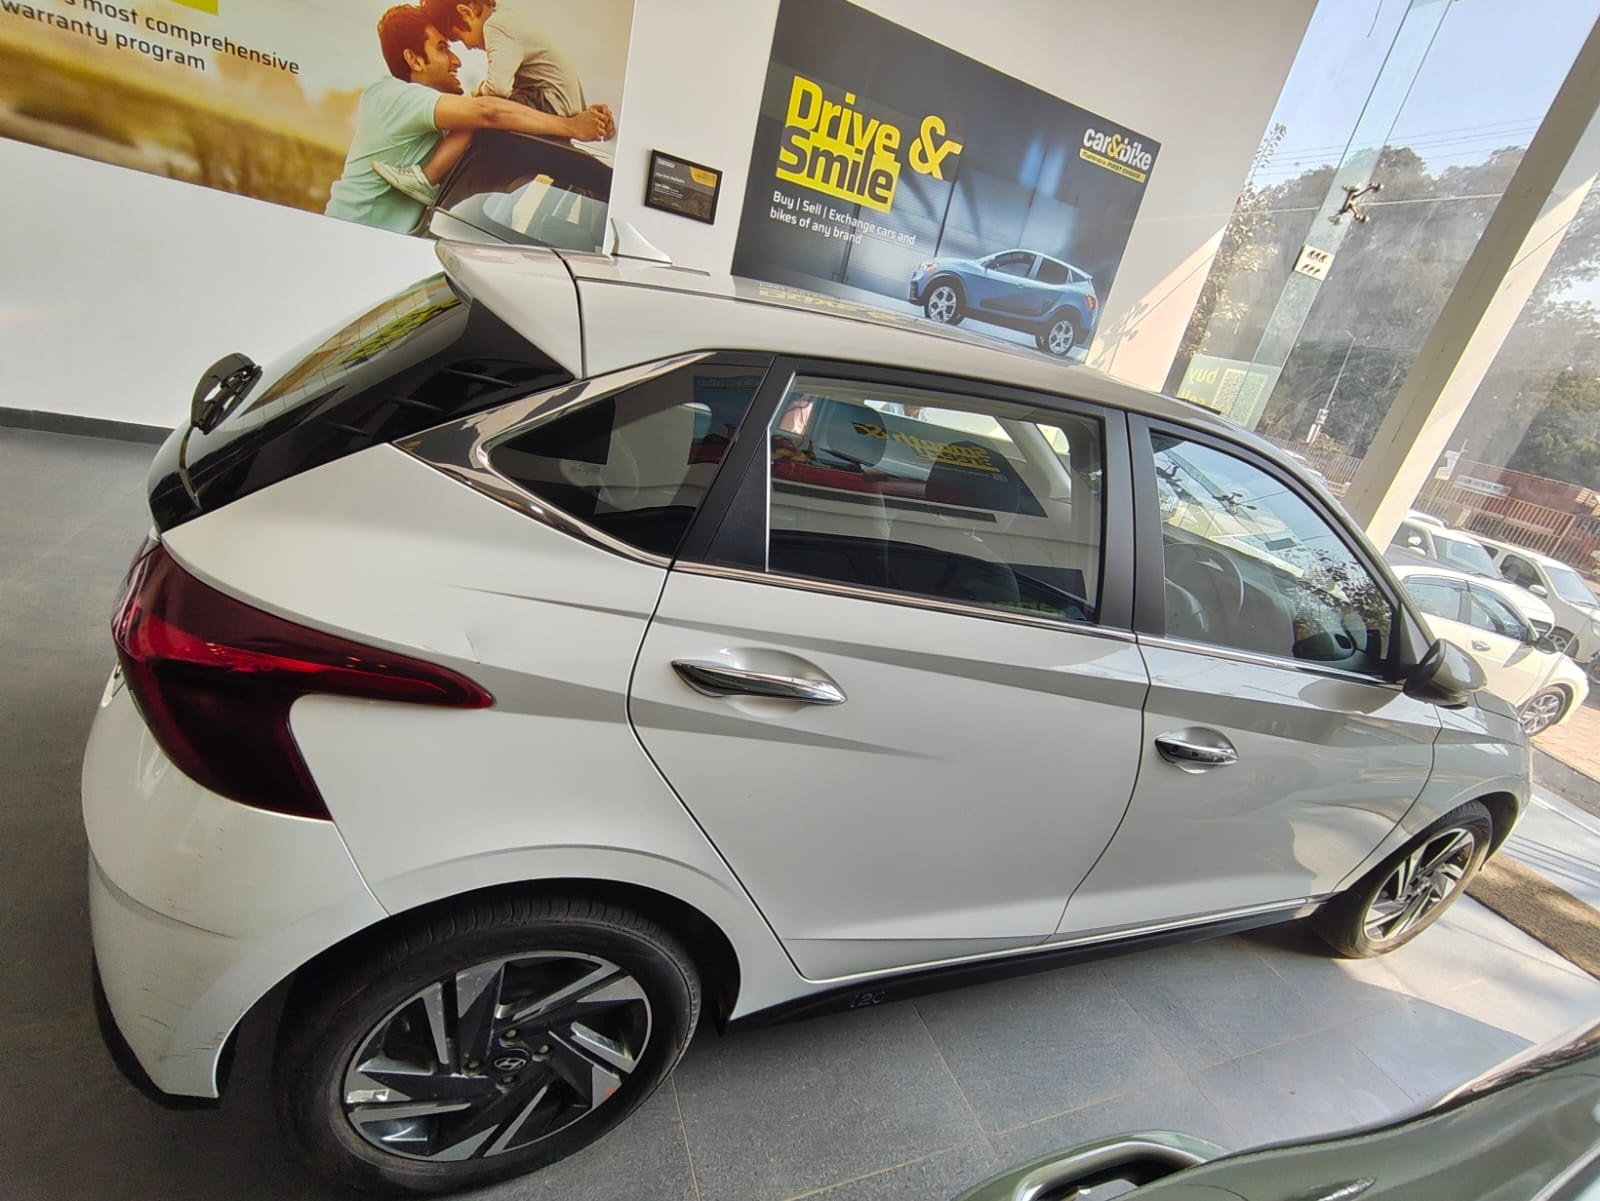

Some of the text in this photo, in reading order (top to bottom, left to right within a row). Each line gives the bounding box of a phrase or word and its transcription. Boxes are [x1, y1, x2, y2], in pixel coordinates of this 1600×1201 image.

[0, 0, 205, 71] warranty program
[83, 0, 300, 75] most comprehensive
[785, 75, 964, 181] Drive &
[1083, 128, 1152, 171] car&bike
[776, 125, 895, 204] Smile
[770, 206, 863, 245] bikes of any brand
[773, 190, 794, 210] Buy
[802, 201, 822, 216] Sell
[828, 209, 876, 234] Exchange
[876, 226, 897, 240] cars
[897, 233, 917, 246] and
